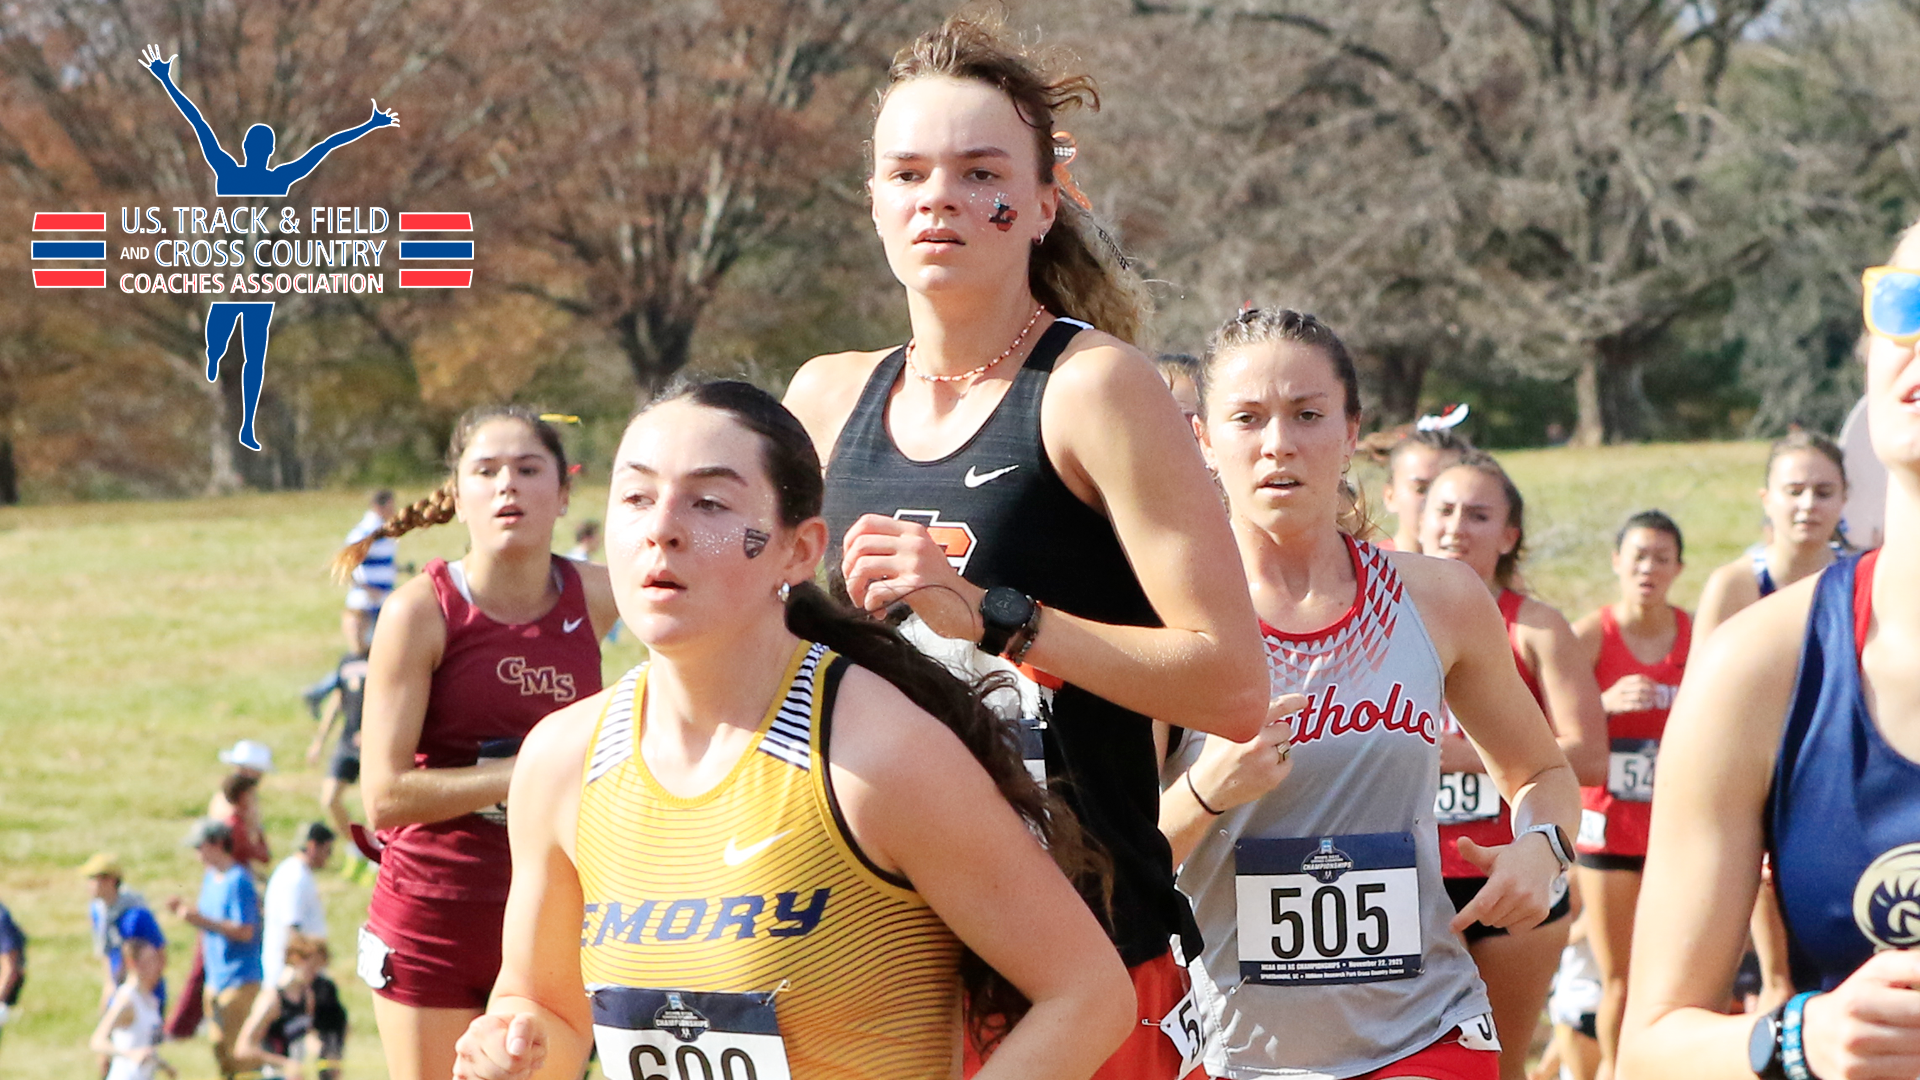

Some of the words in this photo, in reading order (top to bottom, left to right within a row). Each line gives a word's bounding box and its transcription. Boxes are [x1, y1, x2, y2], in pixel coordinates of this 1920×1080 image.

[496, 656, 576, 702] CMS
[1273, 682, 1437, 746] tholic
[1270, 883, 1389, 959] 505
[1178, 998, 1207, 1064] 5
